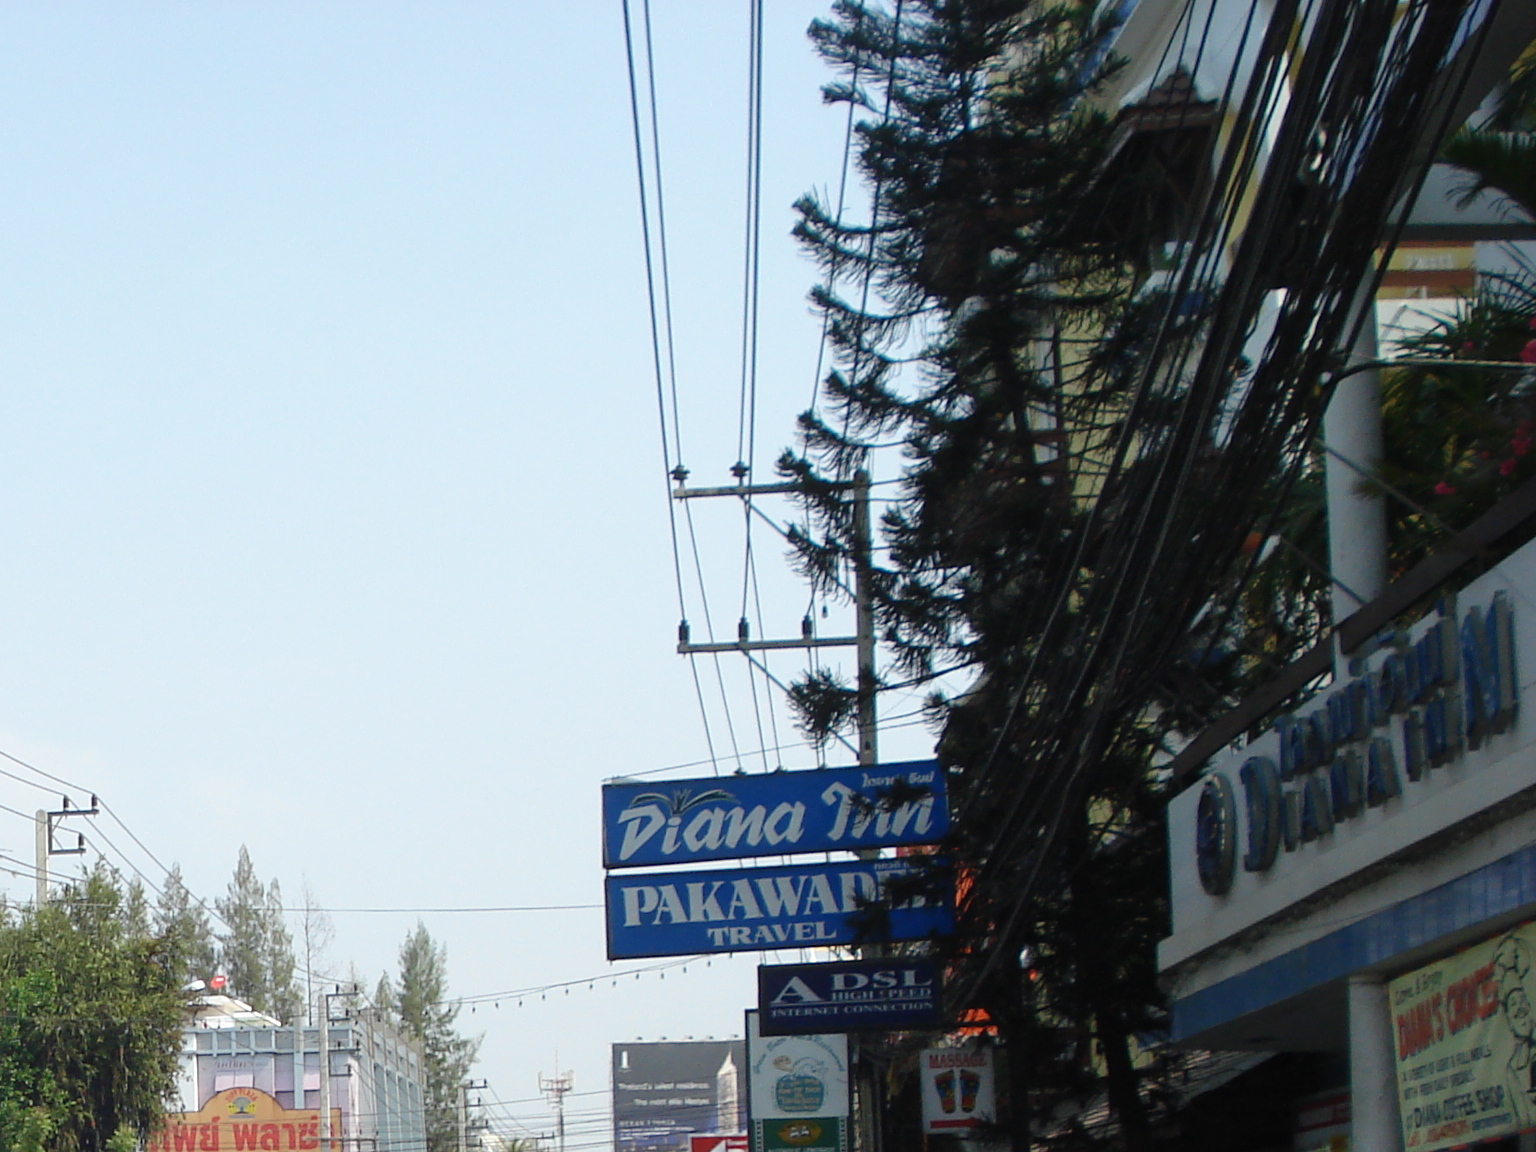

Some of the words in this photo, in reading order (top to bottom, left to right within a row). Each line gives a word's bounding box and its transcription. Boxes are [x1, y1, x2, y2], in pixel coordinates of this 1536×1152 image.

[617, 799, 806, 862] Diana
[820, 781, 935, 843] Inn
[707, 921, 838, 947] TRAVEL
[831, 990, 875, 1001] HIGH
[772, 1006, 839, 1018] INTERNET
[843, 1002, 933, 1015] CONNECTION
[1396, 992, 1444, 1060] DIANA'S
[928, 1052, 987, 1069] MASSAGE
[1476, 1084, 1505, 1112] SHOP
